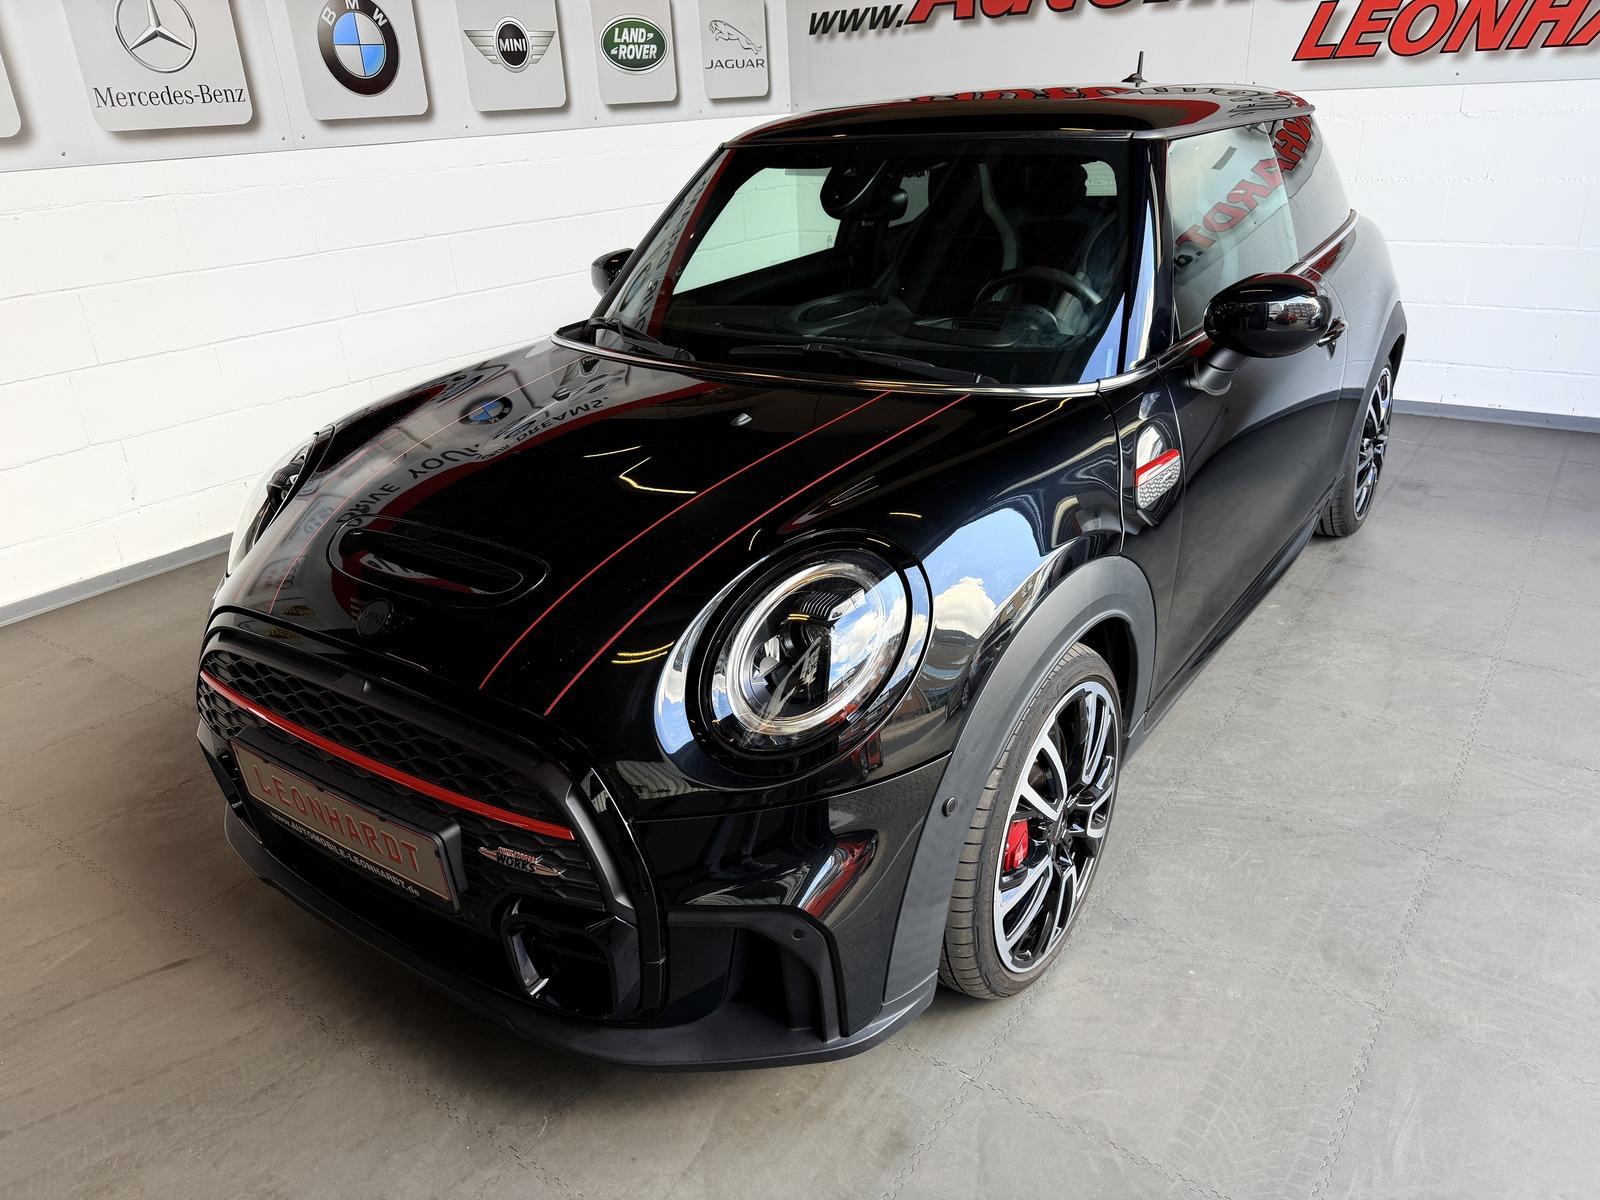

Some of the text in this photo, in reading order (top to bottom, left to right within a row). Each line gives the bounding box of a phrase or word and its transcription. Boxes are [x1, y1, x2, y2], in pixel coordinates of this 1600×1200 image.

[613, 26, 646, 44] LAND
[1291, 0, 1600, 62] LEONH
[498, 37, 527, 53] MINI
[617, 43, 658, 61] ROVER
[704, 57, 766, 70] JAGUAR
[91, 83, 247, 109] Mercedes-Benz
[252, 763, 421, 874] LEONHARDT
[270, 810, 422, 898] www.AUTOMOBILE-LEONHARDT.de
[495, 853, 537, 873] WORKS
